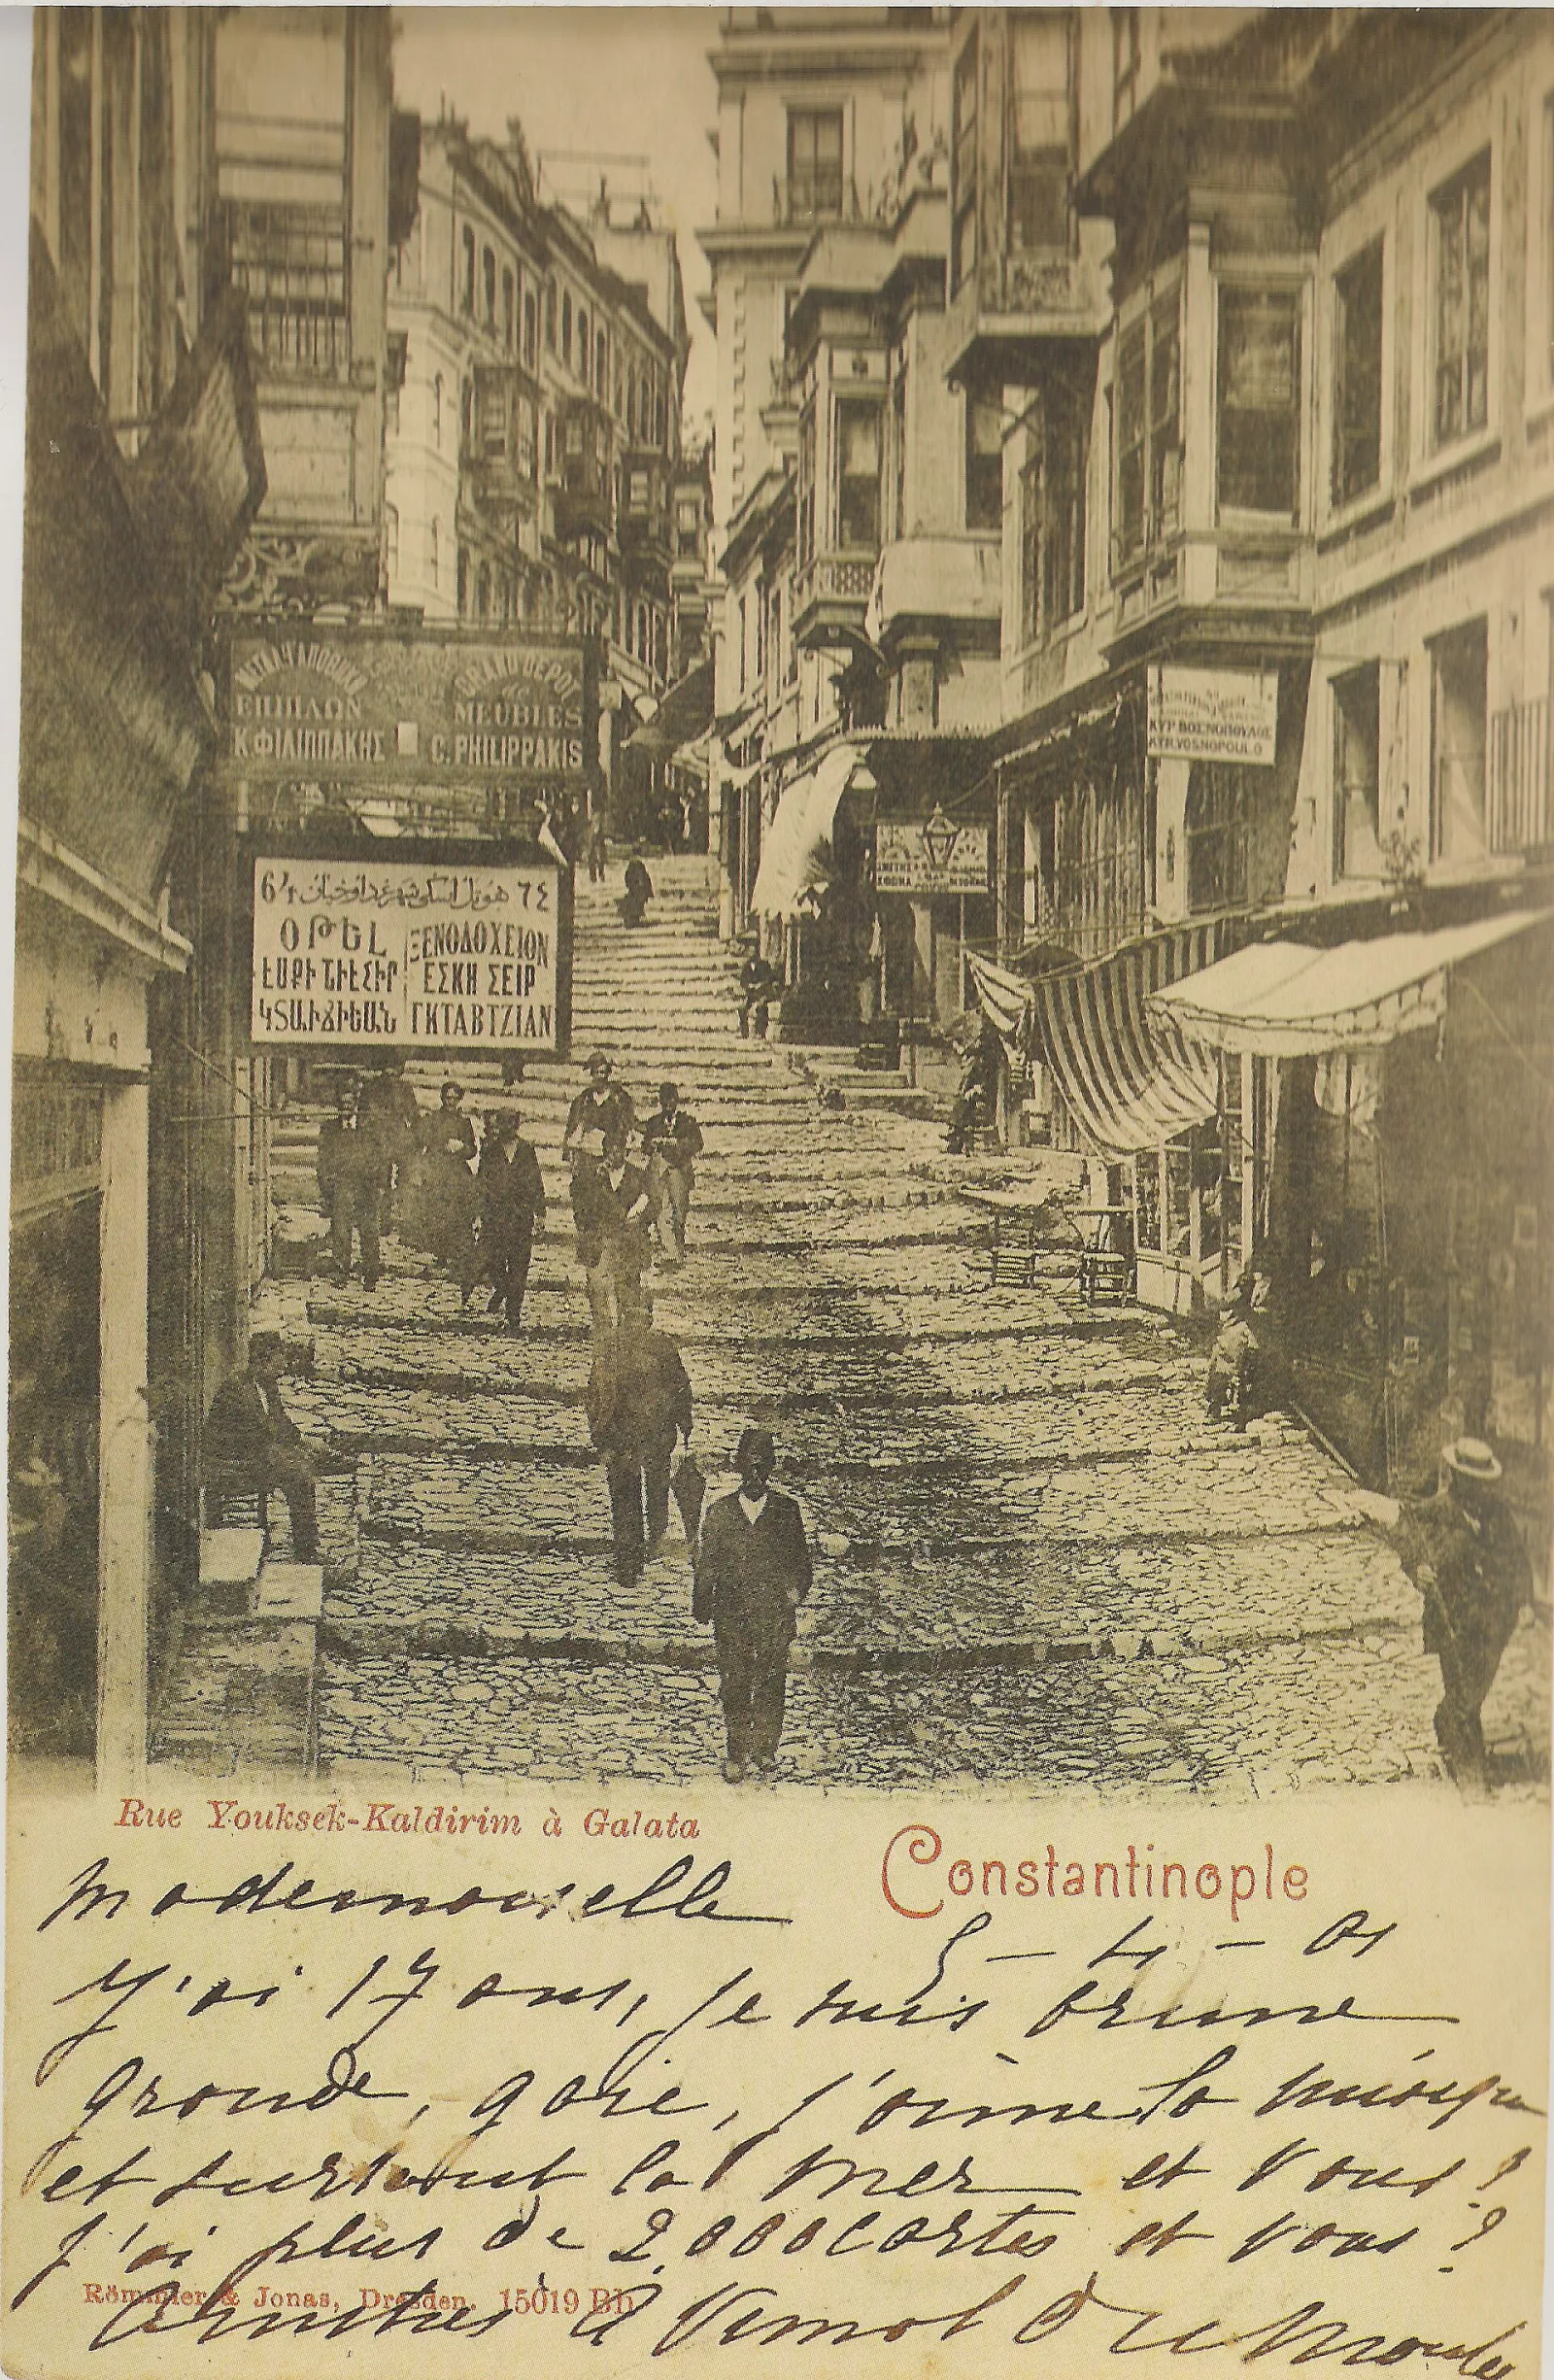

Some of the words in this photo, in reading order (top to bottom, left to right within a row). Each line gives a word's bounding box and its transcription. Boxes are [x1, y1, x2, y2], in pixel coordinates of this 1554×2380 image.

[522, 652, 583, 701] DEPOT
[453, 701, 584, 729] MEUBLES
[430, 731, 452, 765] C.
[454, 733, 585, 768] PHILIPPAKIS
[410, 920, 550, 969] ΞΕΝΟΔΟΧΕΙΟΝ
[423, 961, 478, 996] ΕΣΚΗ
[488, 963, 536, 997] ΣΕΙΡ
[412, 1002, 553, 1038] ΓΚΤΑΒΤΖΙΑΝ
[41, 2146, 157, 2204] et
[1121, 2141, 1213, 2192] et
[1113, 2211, 1215, 2257] et
